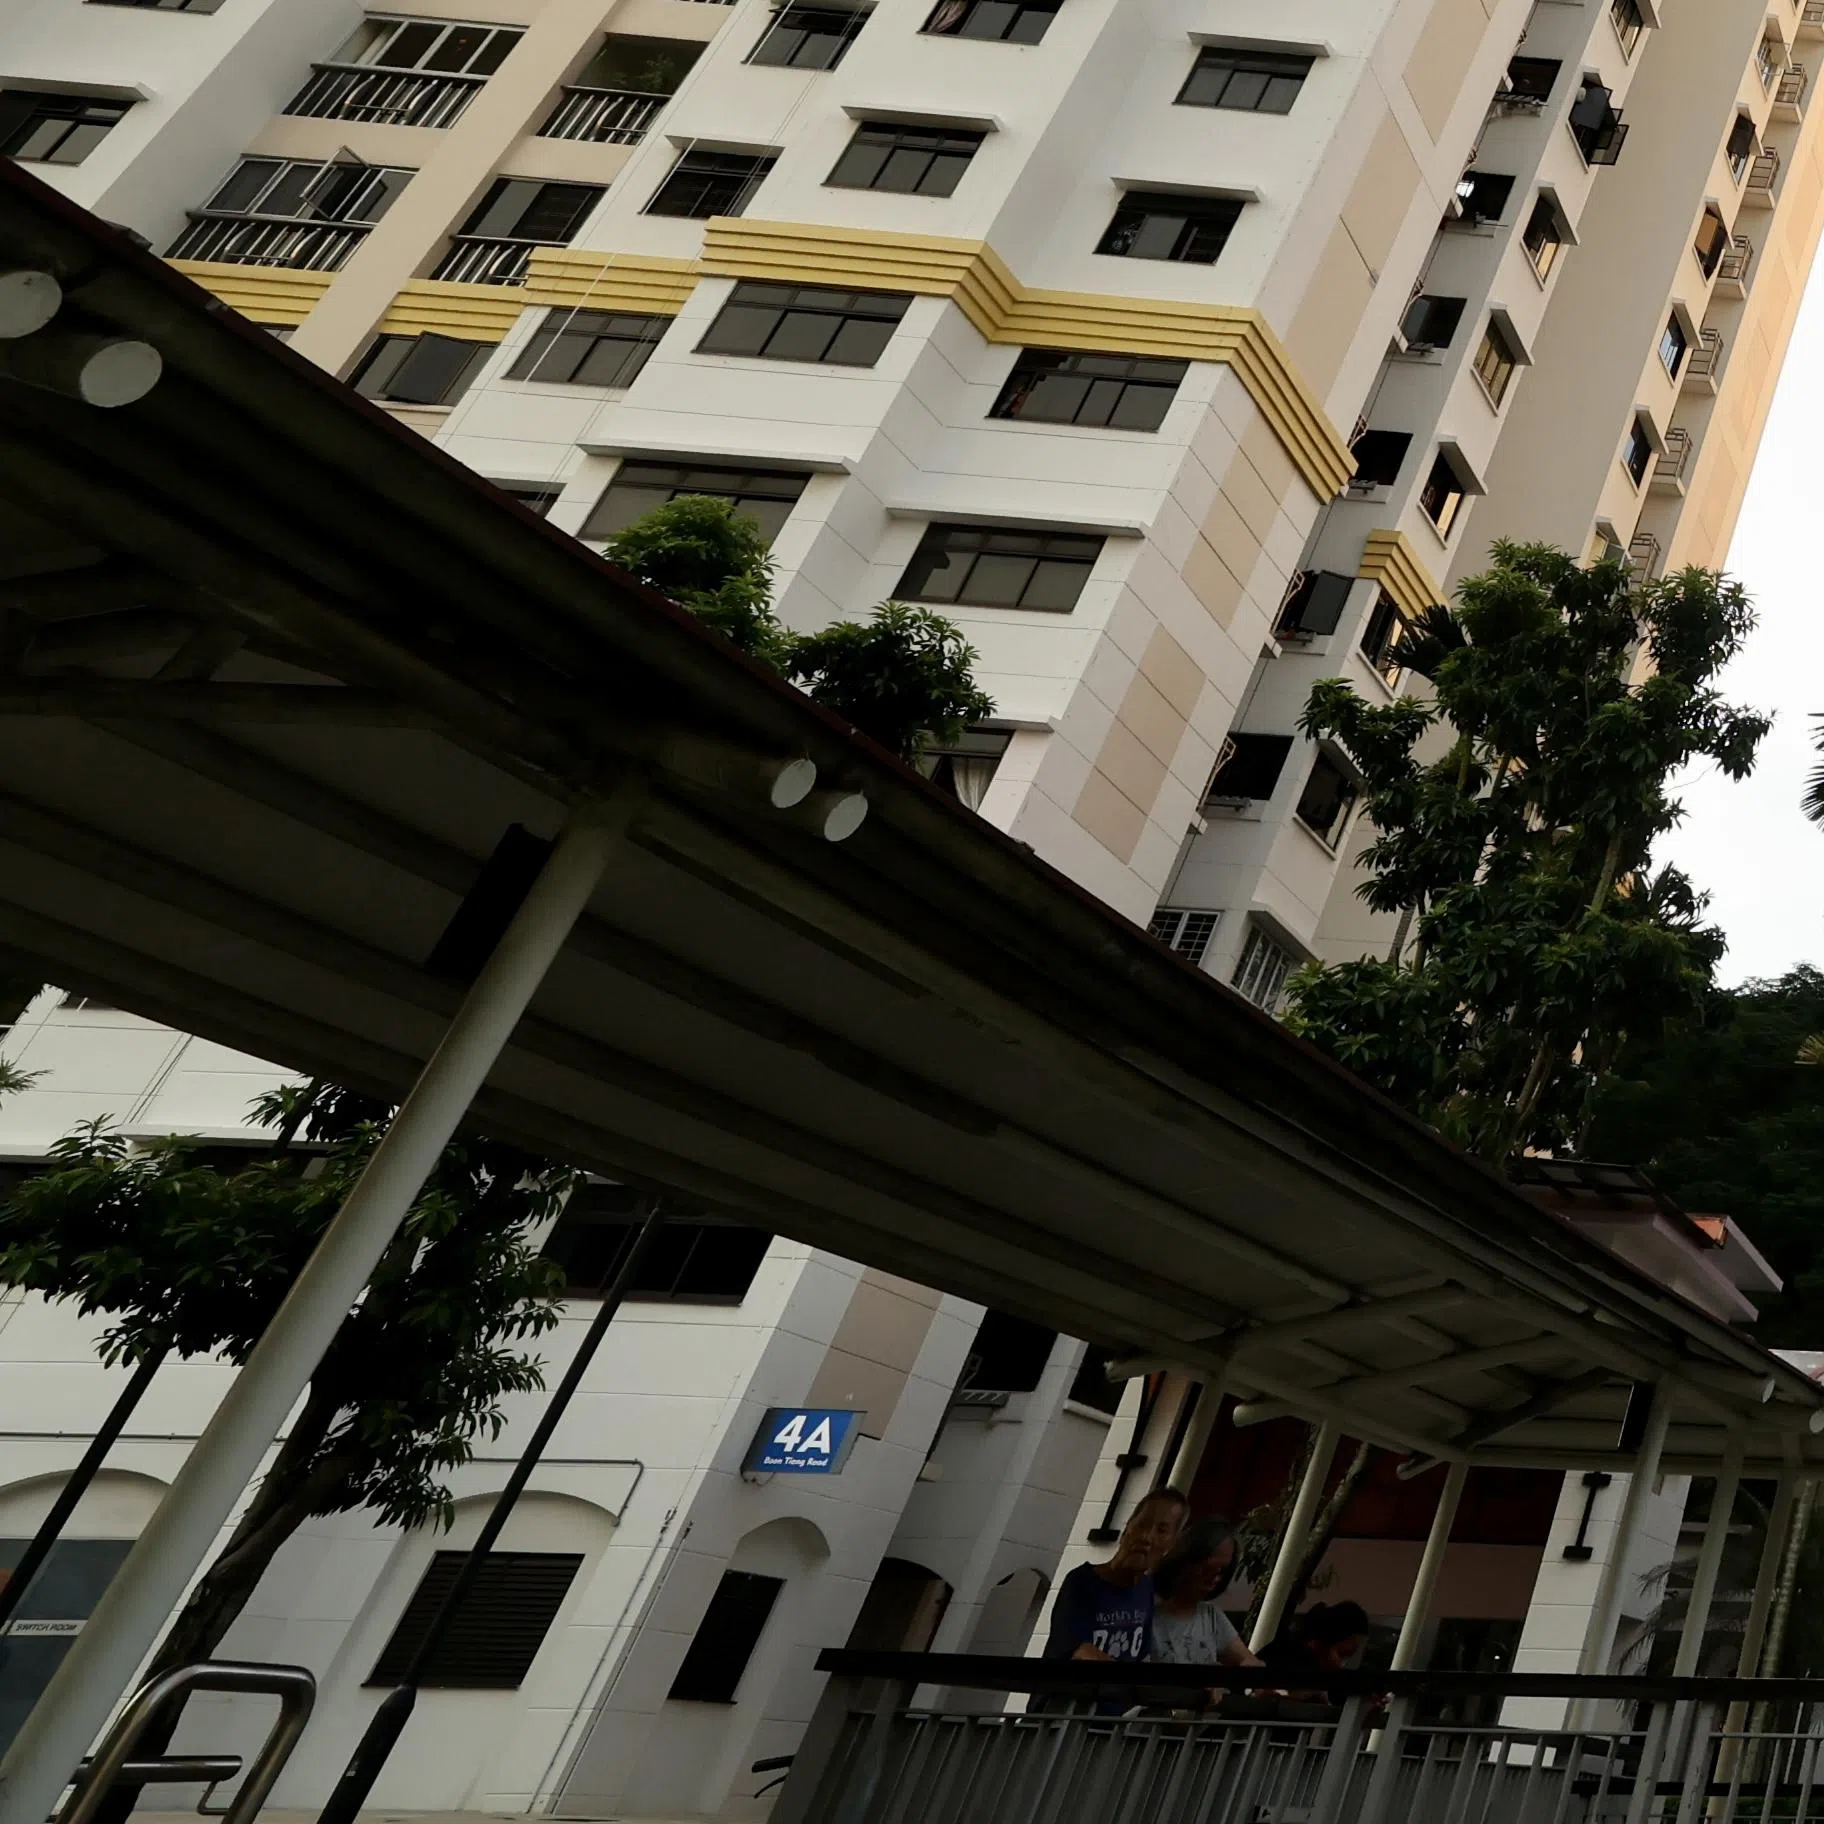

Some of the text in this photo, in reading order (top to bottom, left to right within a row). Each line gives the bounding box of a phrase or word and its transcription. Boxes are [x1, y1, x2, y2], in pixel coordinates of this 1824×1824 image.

[773, 1415, 831, 1454] 4A
[763, 1456, 829, 1467] Boon Tiong Road
